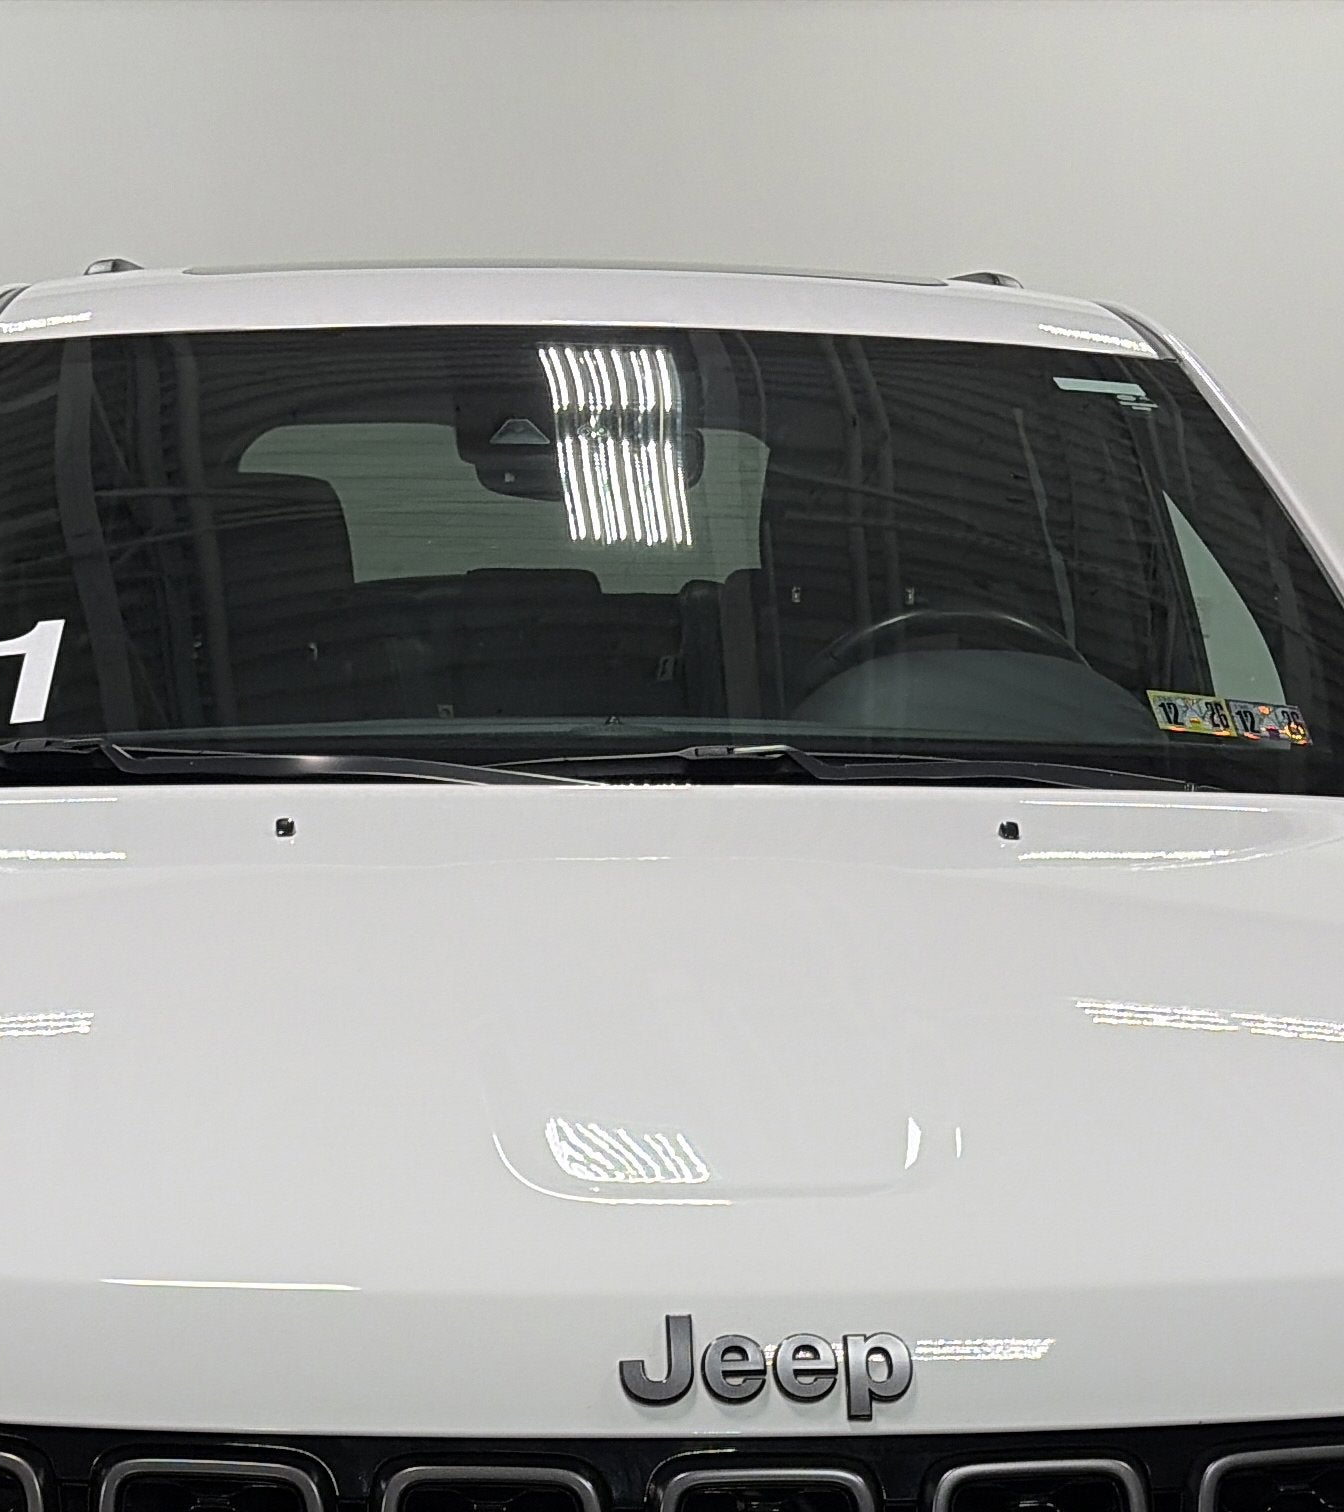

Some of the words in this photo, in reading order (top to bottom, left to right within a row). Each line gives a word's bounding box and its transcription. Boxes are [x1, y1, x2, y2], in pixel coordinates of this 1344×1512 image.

[1158, 702, 1185, 726] 12
[1204, 701, 1230, 728] 26
[1235, 709, 1262, 734] 12
[619, 1314, 914, 1421] Jeep
